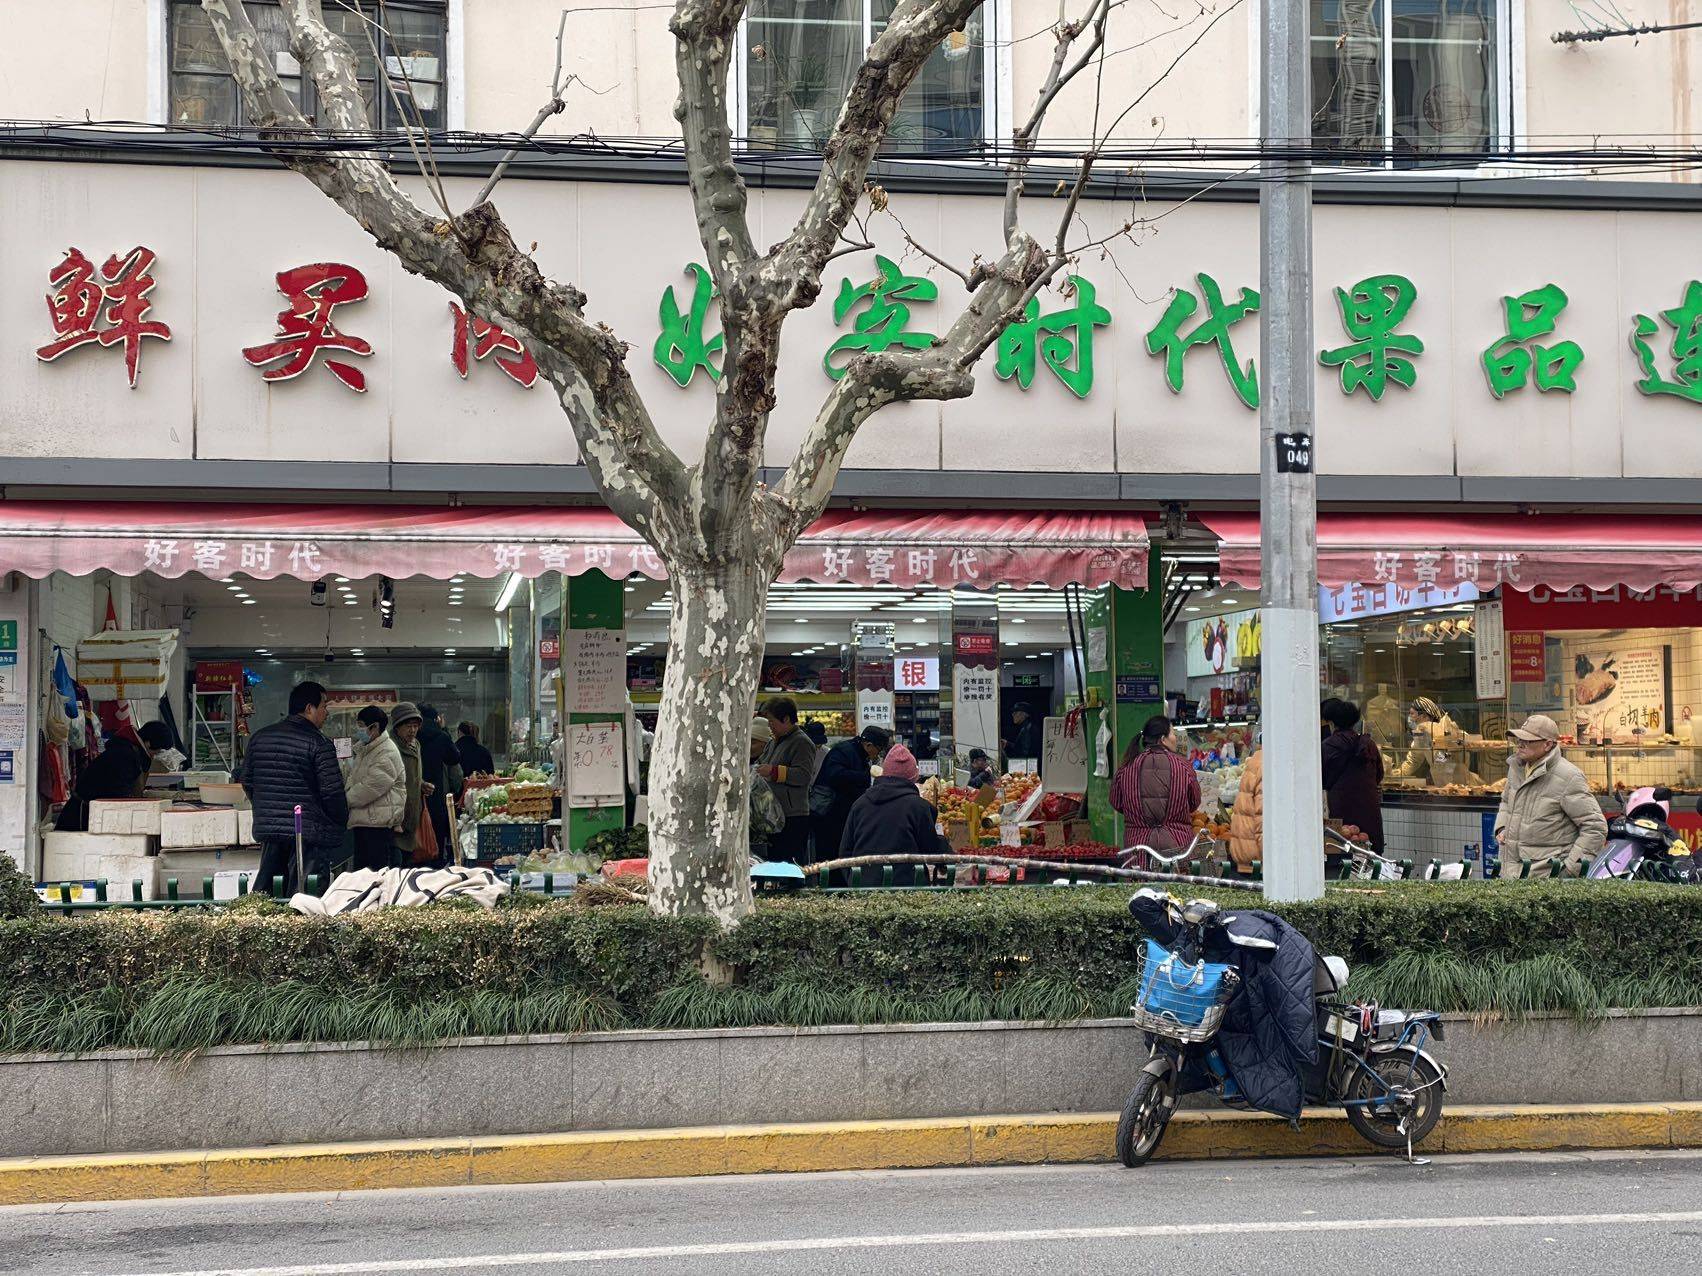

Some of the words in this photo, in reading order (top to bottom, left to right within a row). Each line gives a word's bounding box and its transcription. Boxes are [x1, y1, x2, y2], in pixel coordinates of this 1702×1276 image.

[1287, 450, 1309, 466] 049
[144, 539, 322, 571] 好客时代
[493, 543, 659, 570] 好客时代
[822, 547, 980, 579] 好客时代
[1373, 551, 1521, 582] 好客时代
[1512, 634, 1542, 645] 好消息
[901, 660, 927, 687] 银
[1619, 704, 1661, 728] 白切羊肉
